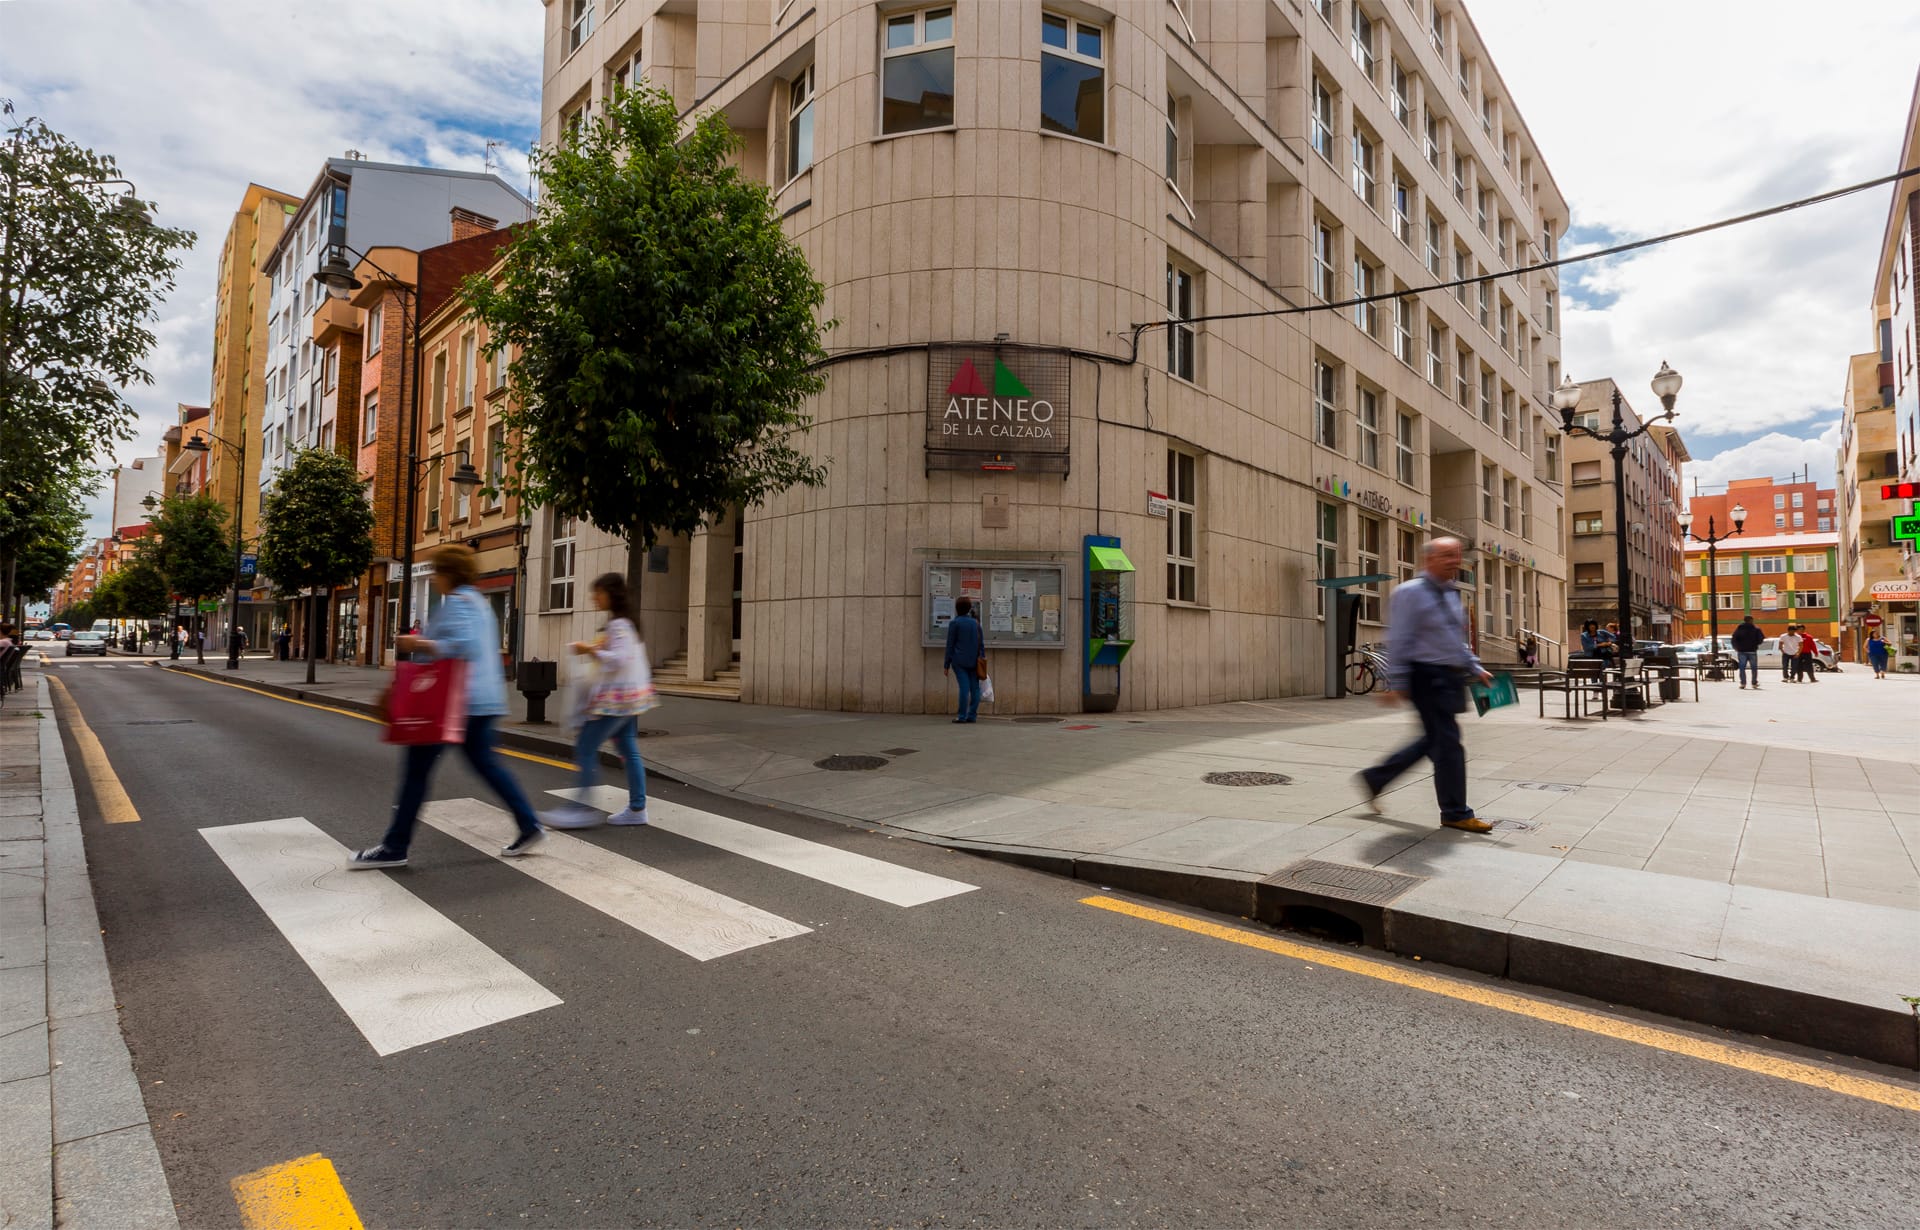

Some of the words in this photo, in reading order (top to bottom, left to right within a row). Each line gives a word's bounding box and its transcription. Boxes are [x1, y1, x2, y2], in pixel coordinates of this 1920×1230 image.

[943, 397, 1054, 423] ATENEO
[943, 423, 959, 436] DE
[967, 424, 983, 436] LA
[990, 424, 1053, 438] CALZADA
[1363, 489, 1390, 513] ATENEO
[1873, 584, 1908, 592] GAGO
